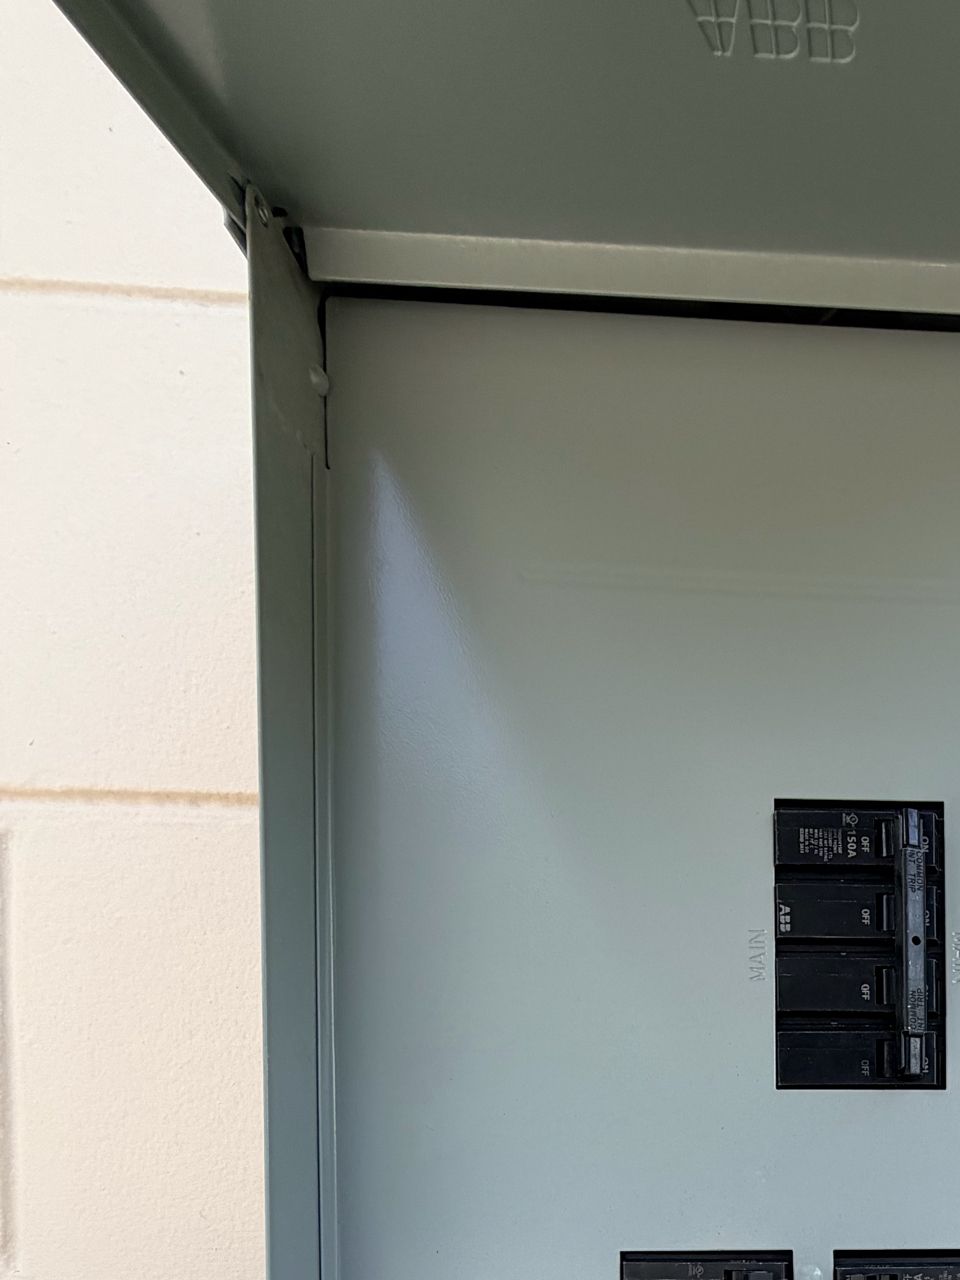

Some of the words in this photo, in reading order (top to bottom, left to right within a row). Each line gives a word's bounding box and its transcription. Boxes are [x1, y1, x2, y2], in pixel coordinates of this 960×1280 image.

[847, 830, 857, 858] 150A
[861, 836, 870, 853] OFF
[921, 836, 929, 852] ON
[907, 874, 916, 893] TRIP
[780, 904, 791, 933] ABB
[861, 908, 870, 926] OFF
[748, 929, 767, 981] MAIN
[861, 984, 870, 1001] OFF
[861, 1060, 869, 1077] OFF
